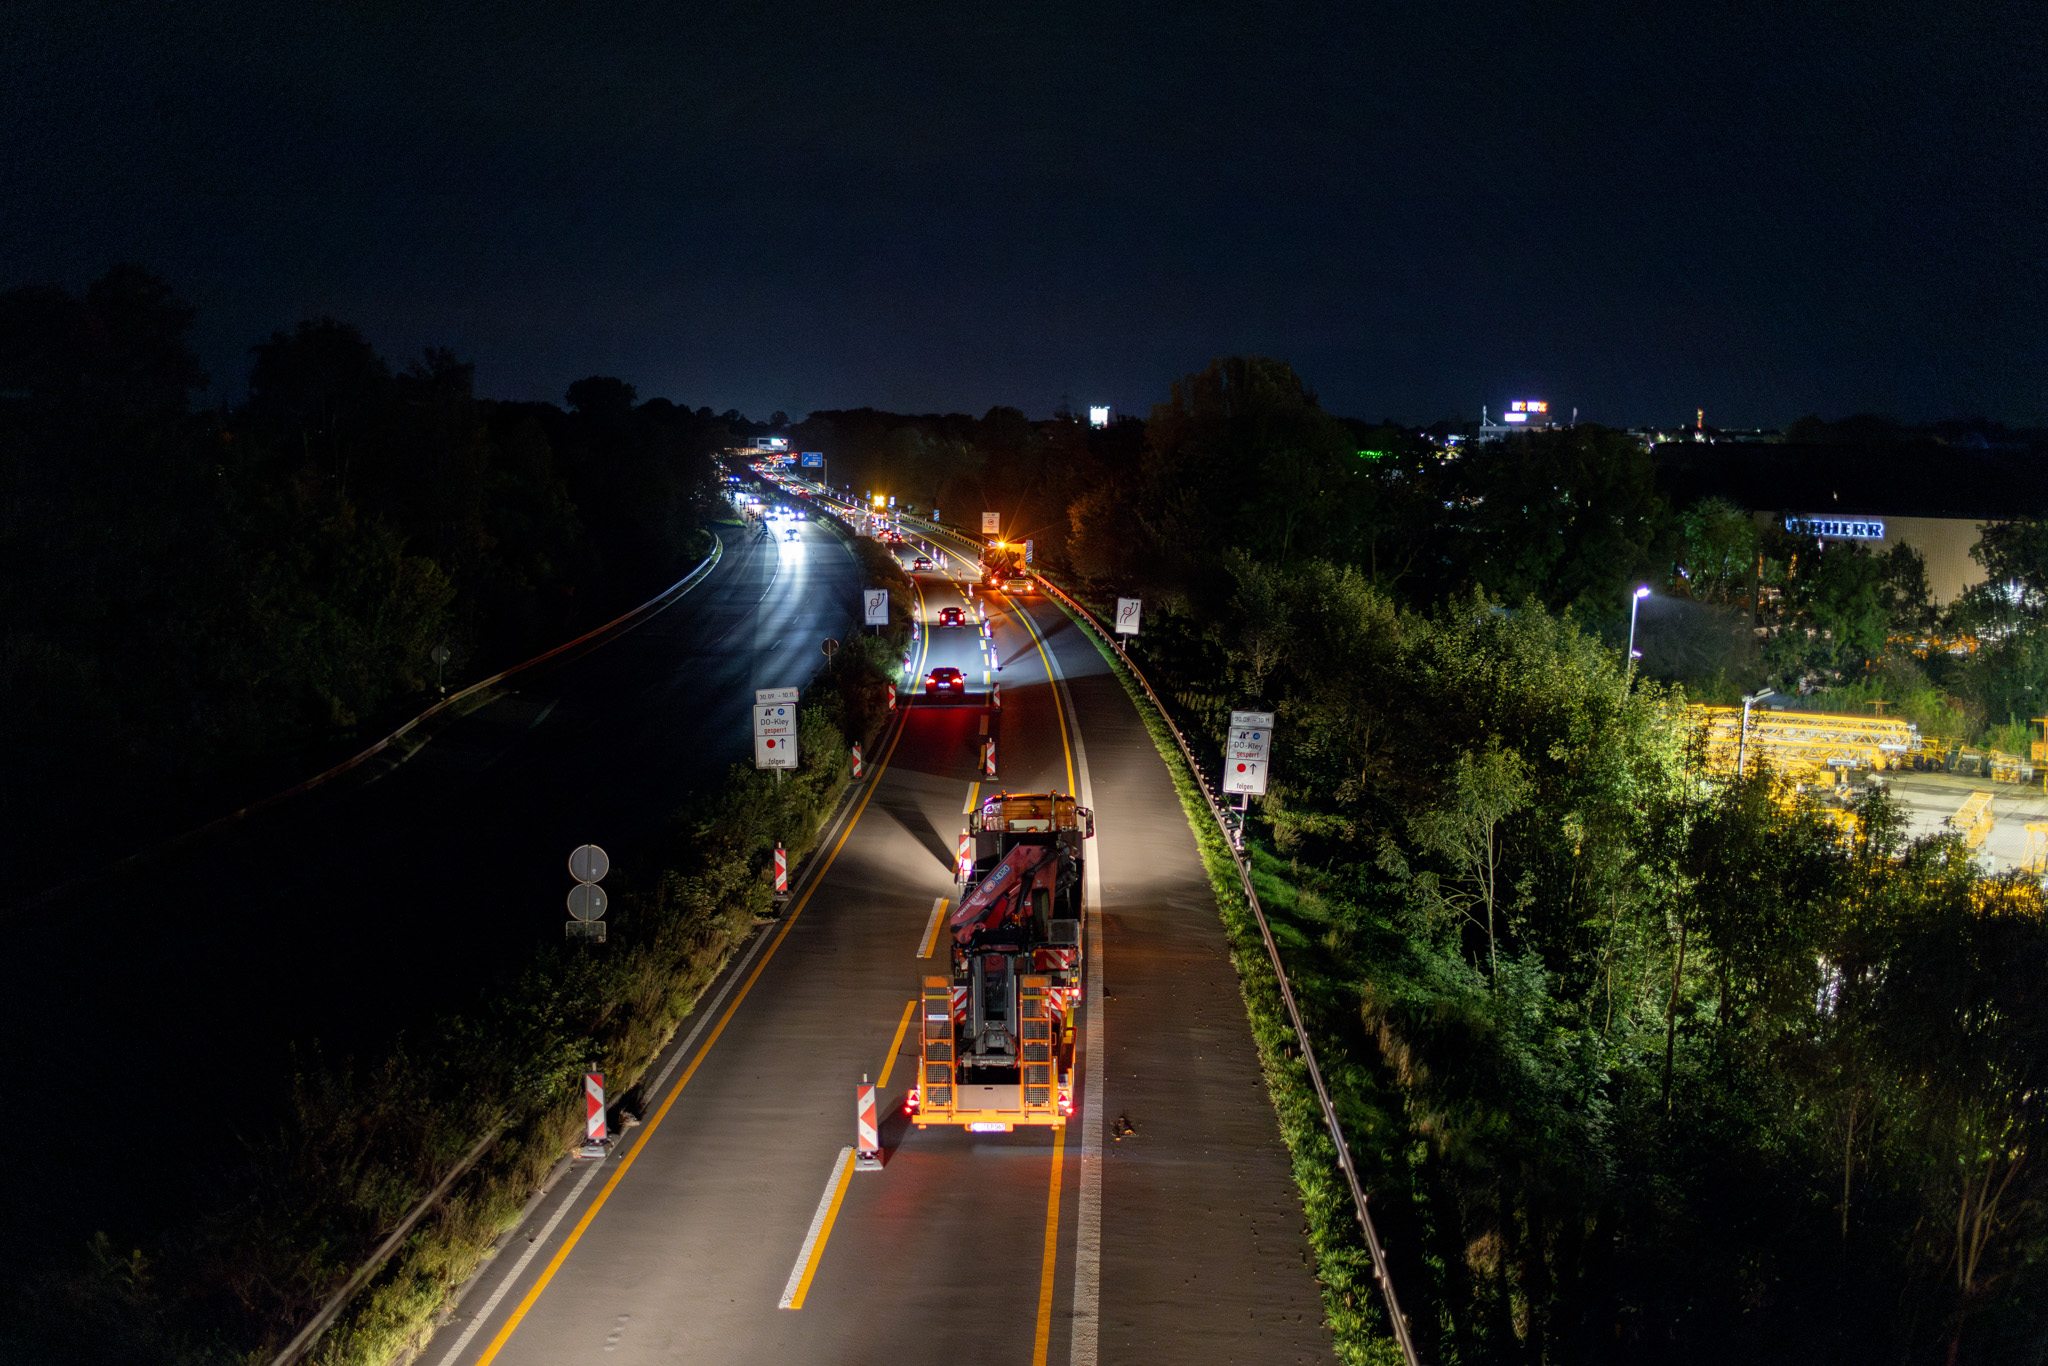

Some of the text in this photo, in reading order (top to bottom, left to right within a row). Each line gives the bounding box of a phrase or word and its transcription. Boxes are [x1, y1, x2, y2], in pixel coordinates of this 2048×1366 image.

[764, 727, 787, 735] gesperrt
[1234, 741, 1263, 751] DO-Kley
[768, 758, 786, 766] folgen
[1236, 782, 1254, 790] folgen
[994, 865, 1011, 881] 4020
[957, 903, 971, 918] POWER
[975, 890, 984, 900] LIFT
